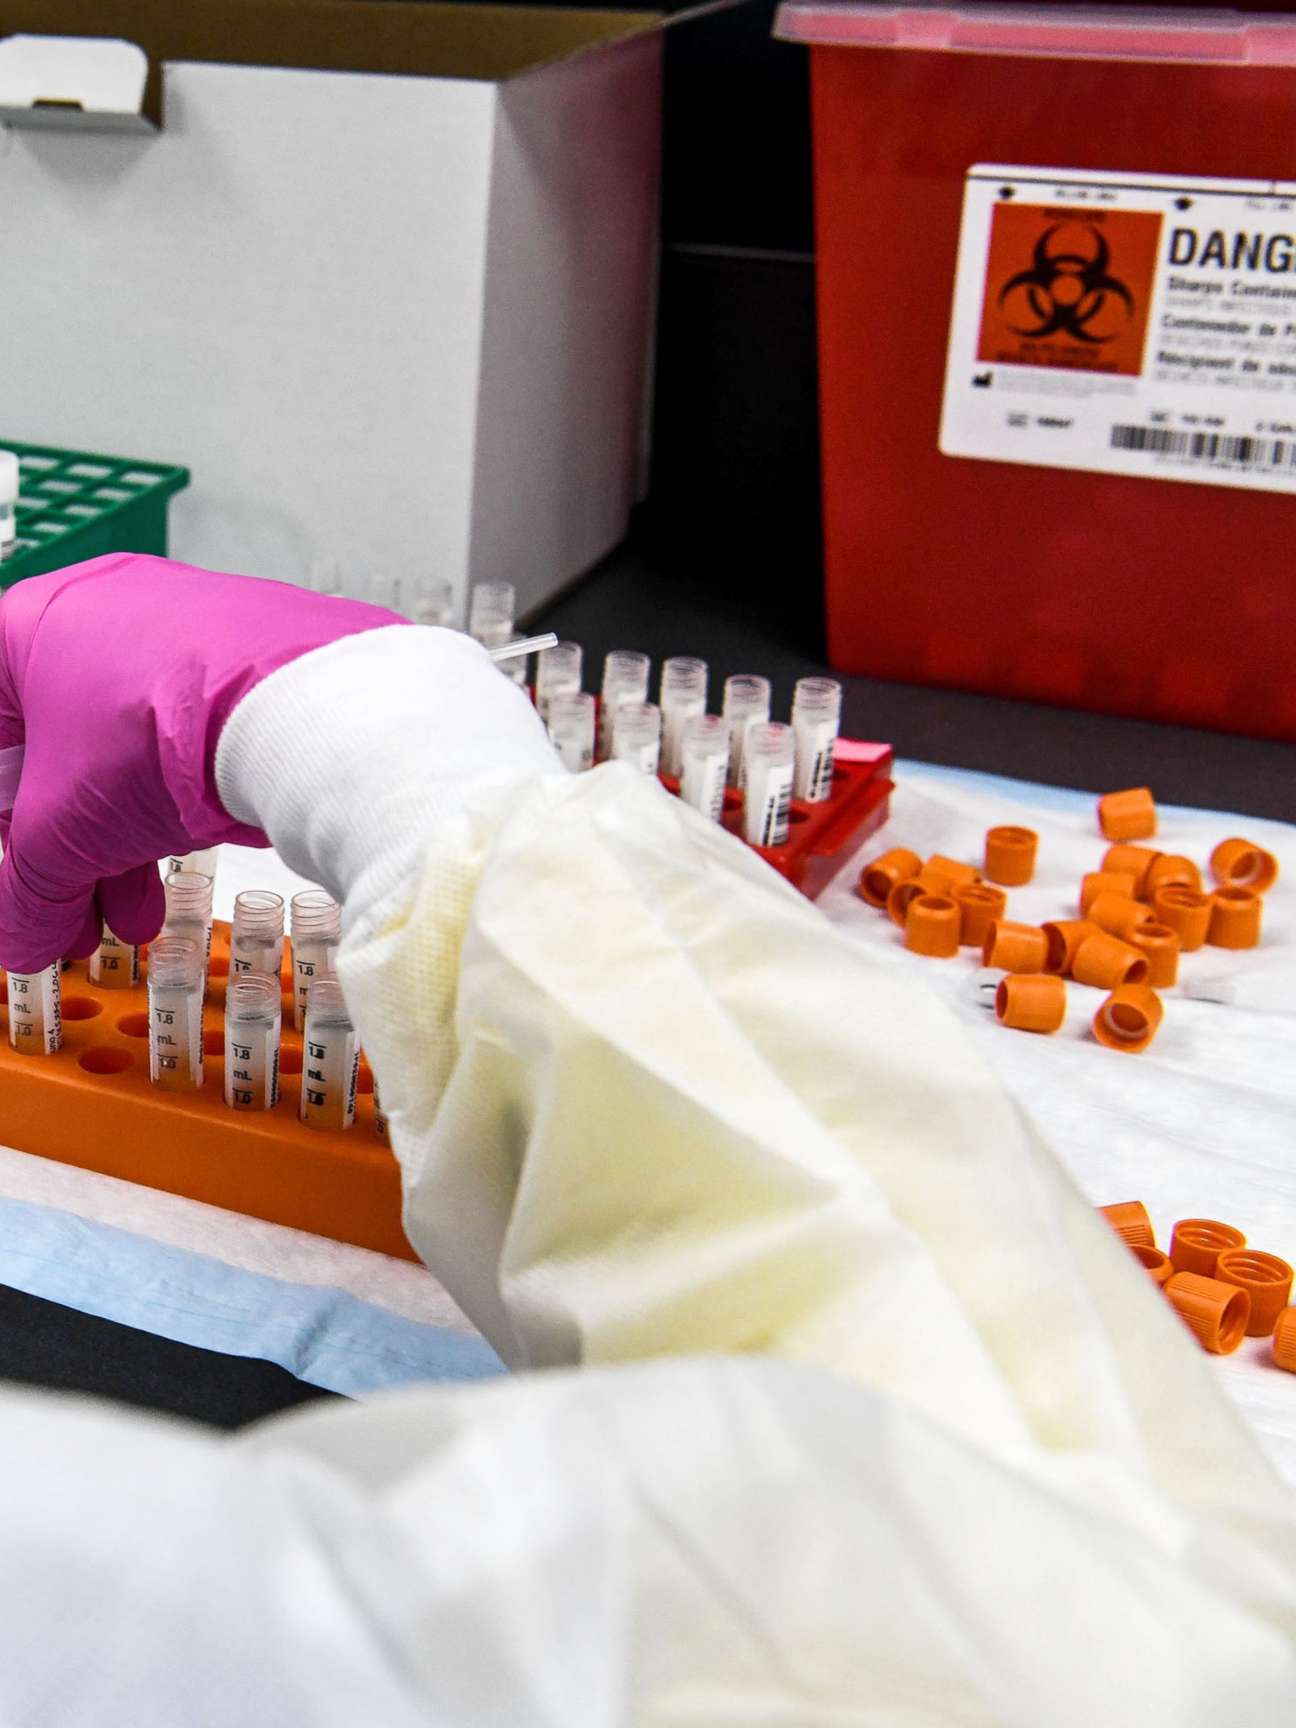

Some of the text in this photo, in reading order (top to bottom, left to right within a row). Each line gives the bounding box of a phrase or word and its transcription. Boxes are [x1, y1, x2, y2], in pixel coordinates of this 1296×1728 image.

[1168, 228, 1296, 273] DANG
[102, 958, 119, 971] 1.0
[299, 965, 314, 976] 1.8
[13, 981, 29, 994] 1.8
[14, 1003, 32, 1015] mL
[156, 1012, 174, 1025] 1.8
[157, 1034, 177, 1046] mL
[233, 1048, 251, 1060] 1.8
[308, 1046, 326, 1060] 1.8
[159, 1057, 176, 1069] 1.0
[233, 1070, 252, 1081] mL
[307, 1069, 326, 1082] mL
[233, 1091, 251, 1104] 1.0
